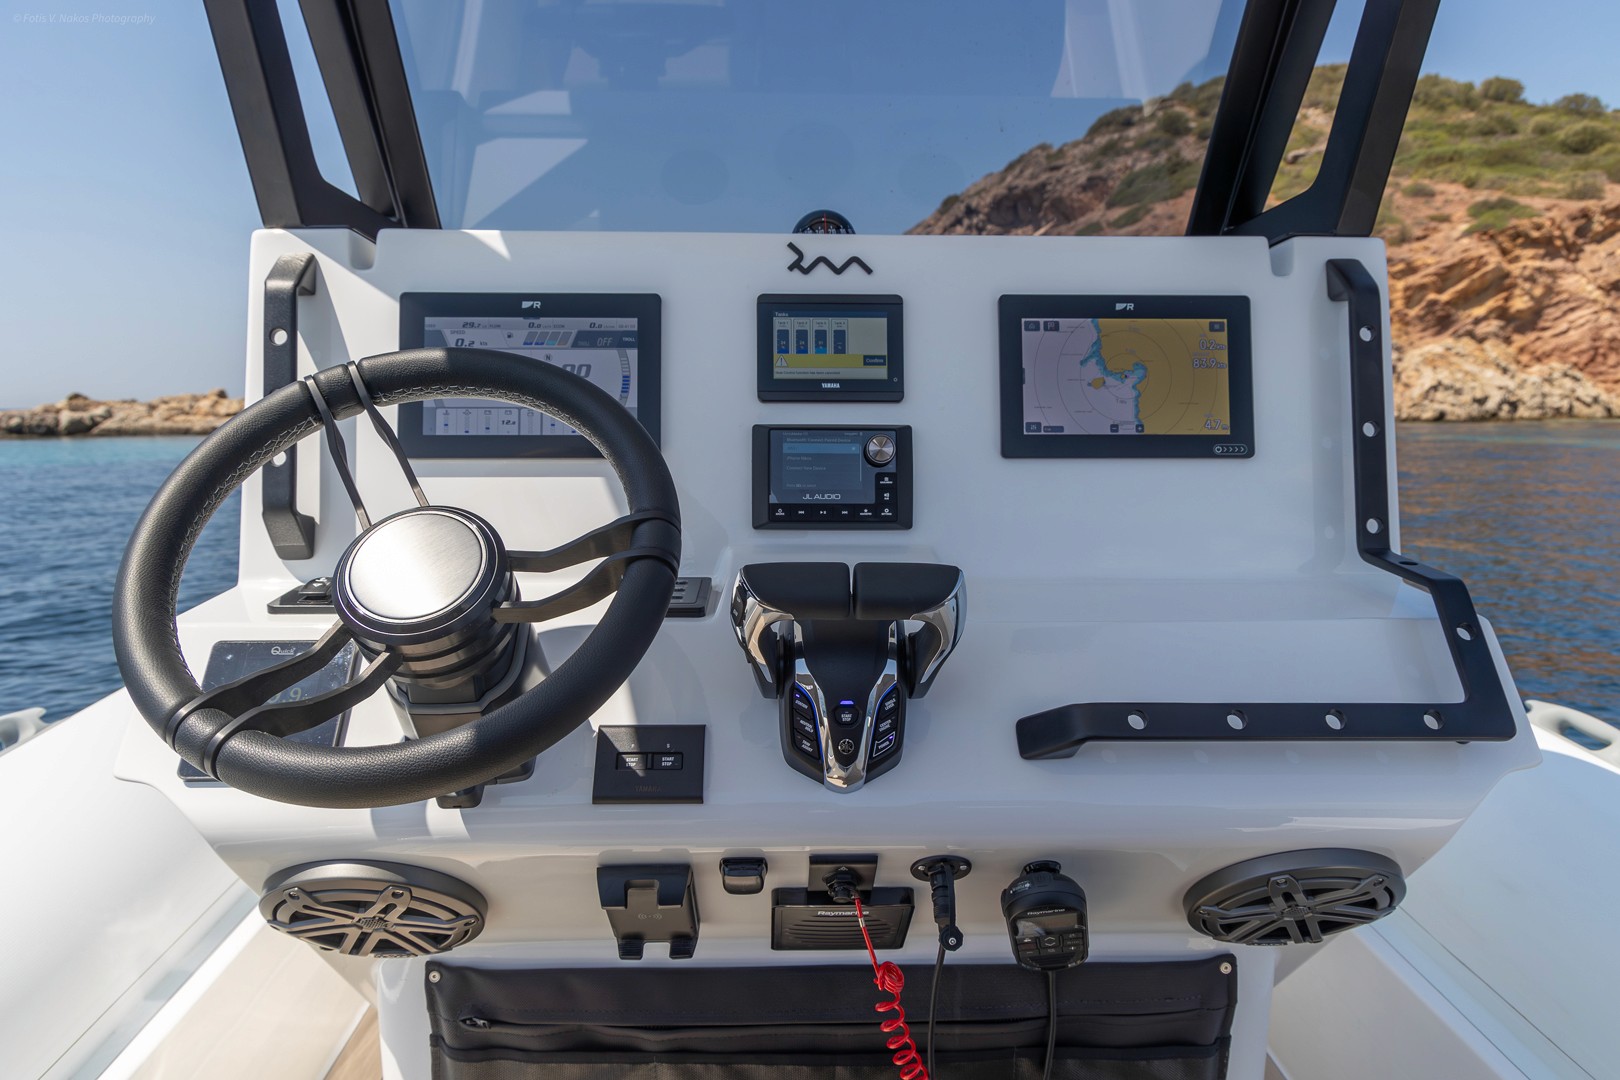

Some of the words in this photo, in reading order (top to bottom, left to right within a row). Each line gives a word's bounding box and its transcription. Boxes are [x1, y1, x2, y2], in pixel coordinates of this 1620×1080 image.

[455, 338, 475, 347] 0.2
[597, 337, 613, 346] OFF
[1199, 339, 1216, 350] 0.2
[1193, 357, 1216, 368] 83.9
[1204, 420, 1220, 430] 4.7
